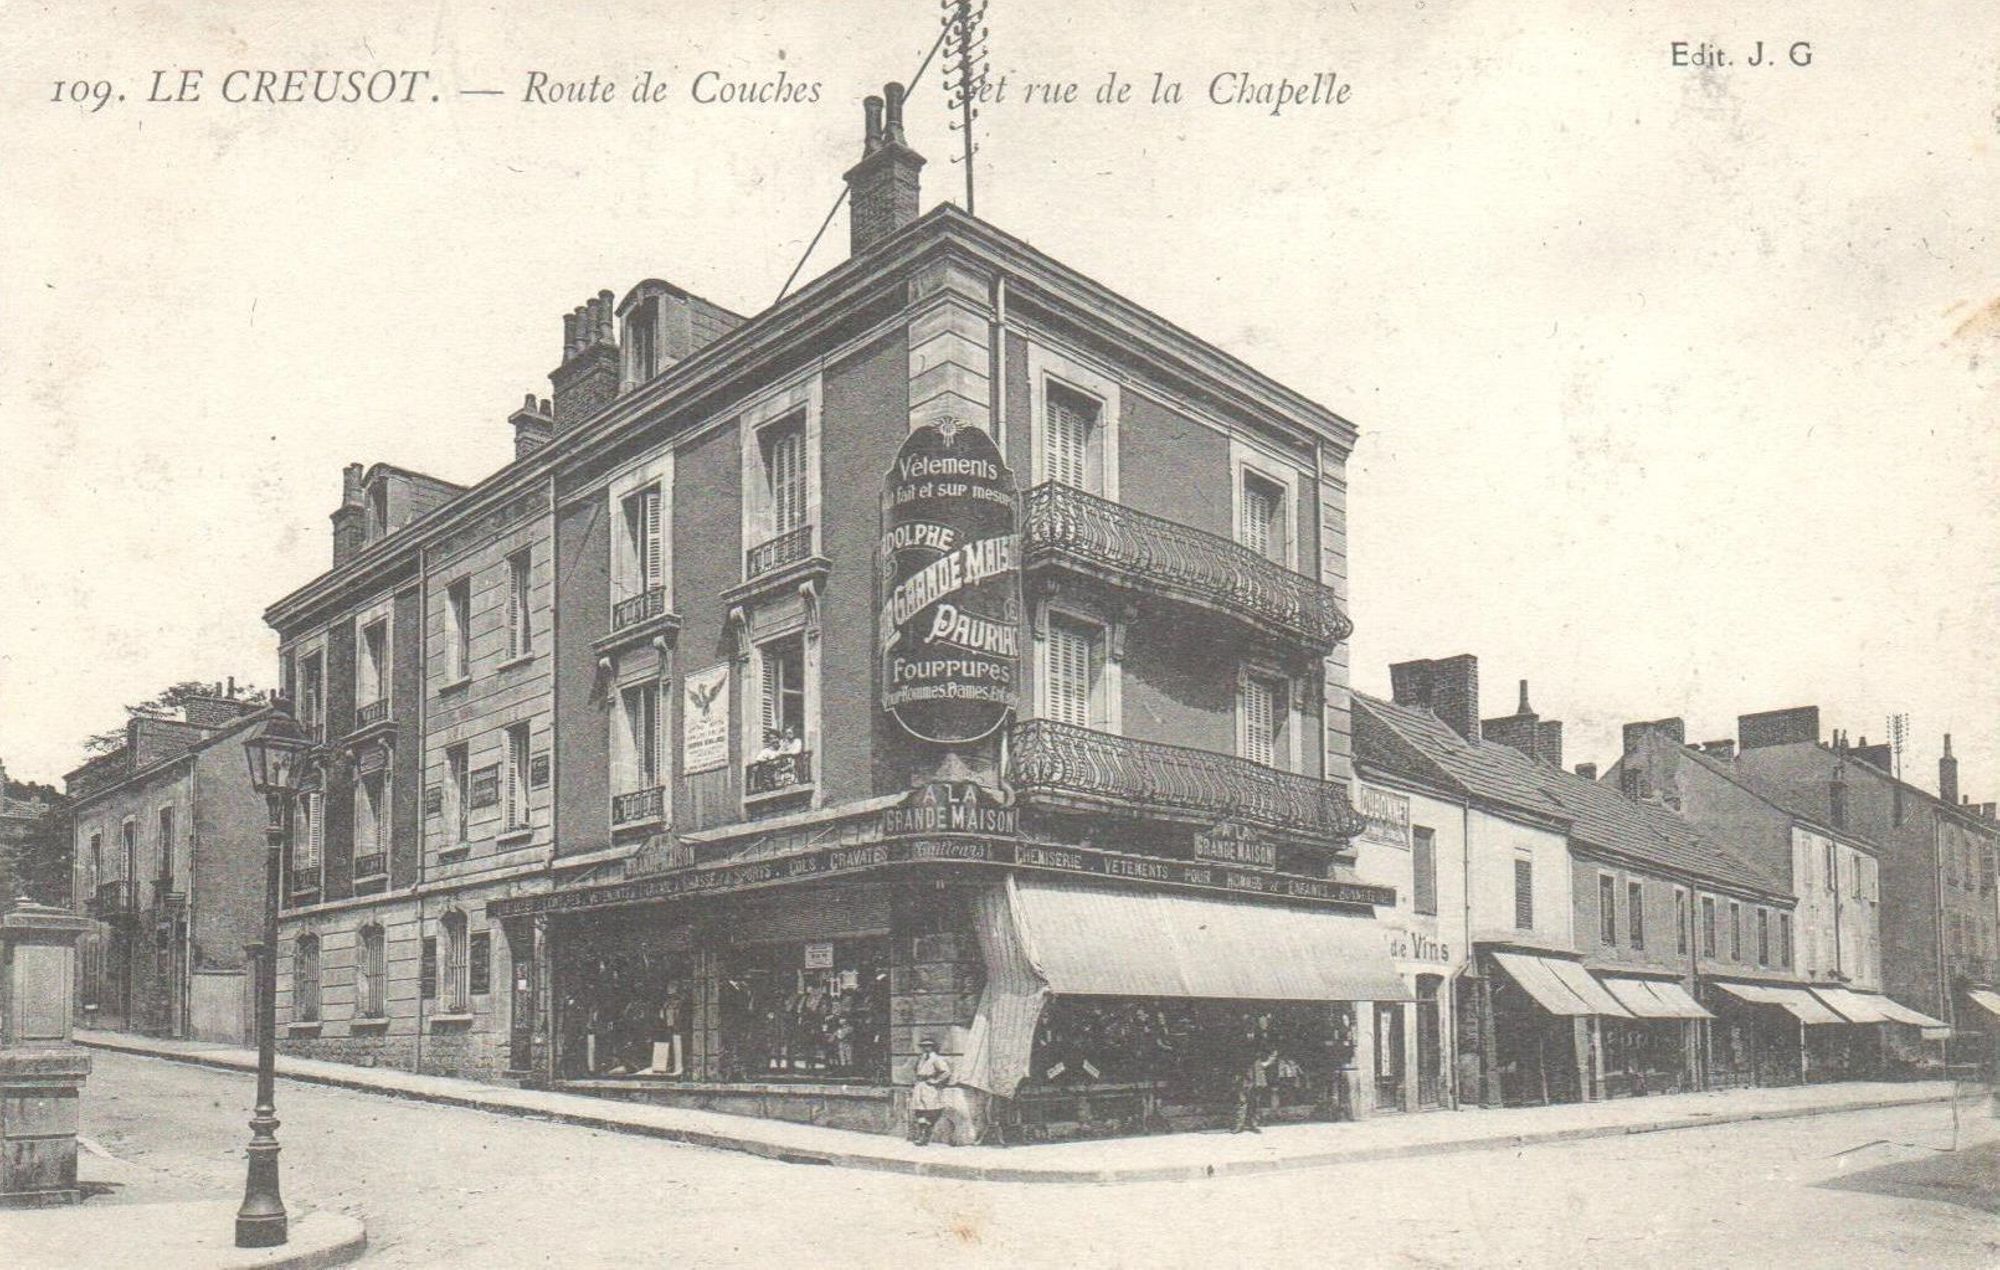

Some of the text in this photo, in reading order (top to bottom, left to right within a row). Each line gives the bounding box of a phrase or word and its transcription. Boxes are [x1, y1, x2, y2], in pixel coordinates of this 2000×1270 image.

[919, 482, 933, 498] et
[882, 524, 955, 555] DOLPHE
[894, 550, 962, 625] GRANDE
[923, 784, 977, 804] A LA
[886, 804, 1015, 833] GRANDE MAISON
[830, 845, 888, 871] CRAVATES
[1015, 845, 1082, 870] CHEMISERIE
[1184, 868, 1211, 884] POUR
[1197, 836, 1273, 866] GRANDE MAISON
[1391, 932, 1449, 962] de Vins
